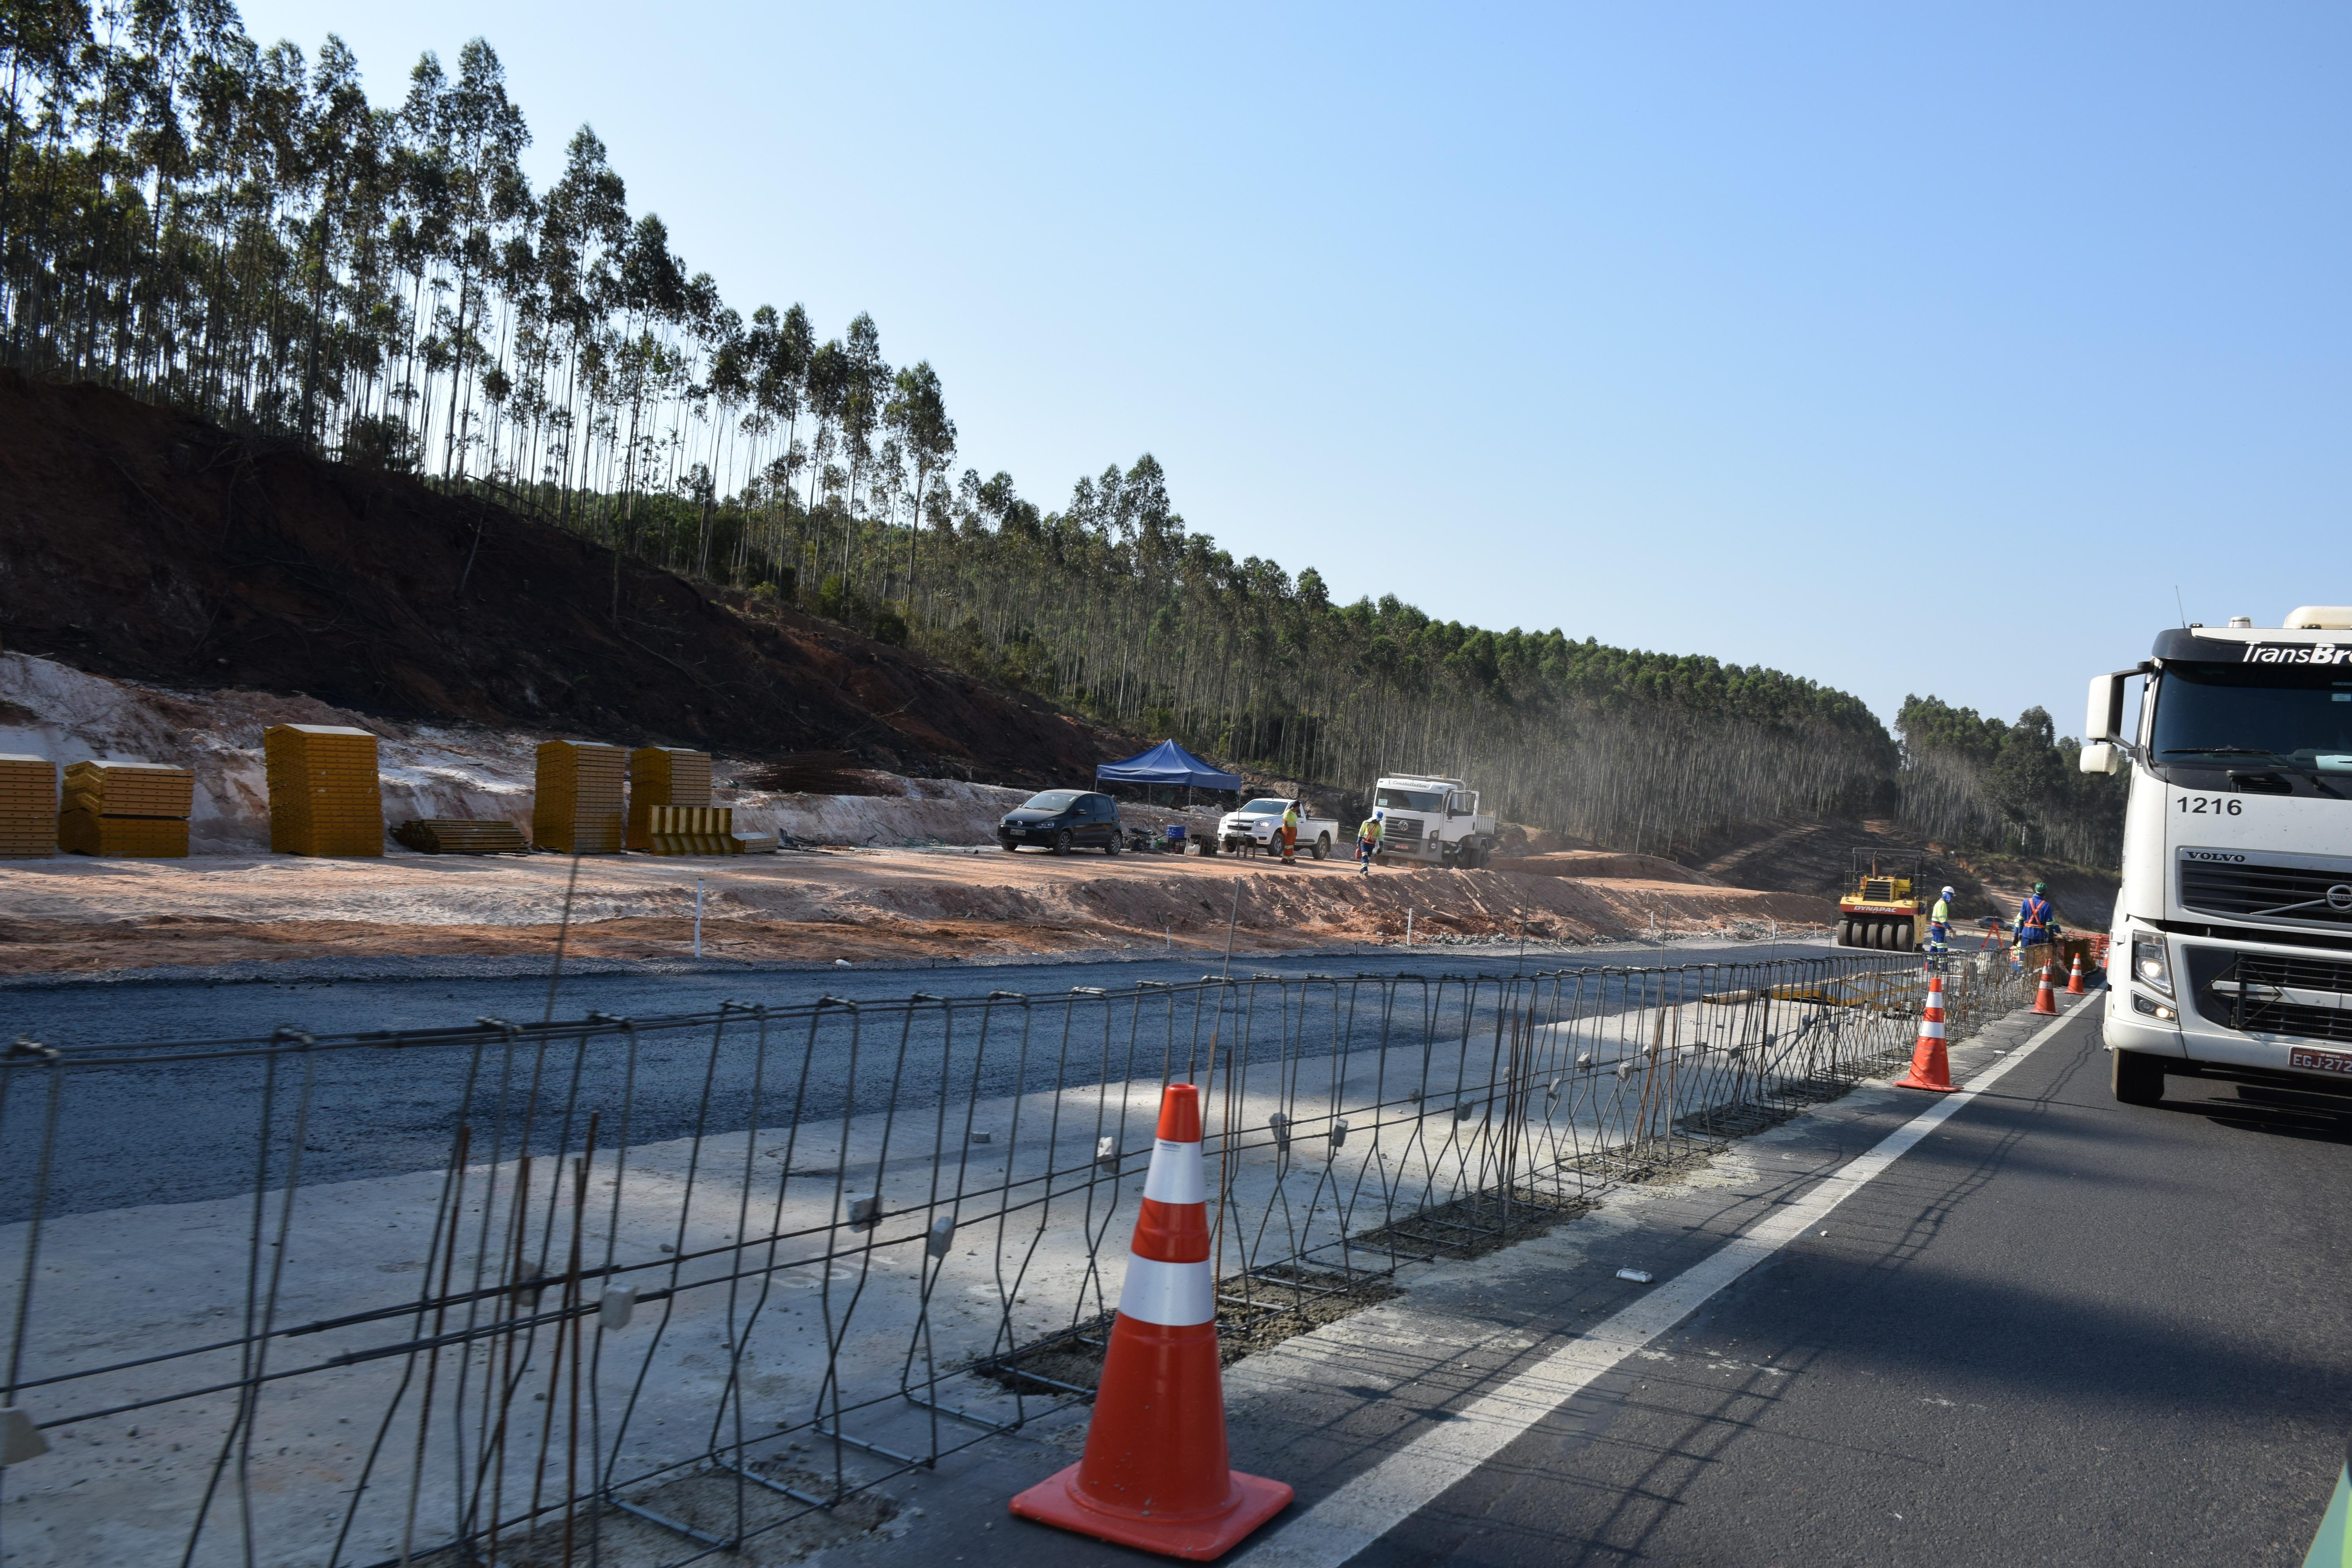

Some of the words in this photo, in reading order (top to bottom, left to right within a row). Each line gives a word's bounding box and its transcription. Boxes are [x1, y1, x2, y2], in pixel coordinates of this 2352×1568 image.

[2243, 641, 2352, 664] TransBr
[2177, 797, 2242, 815] 1216
[2186, 851, 2246, 862] VOLVO
